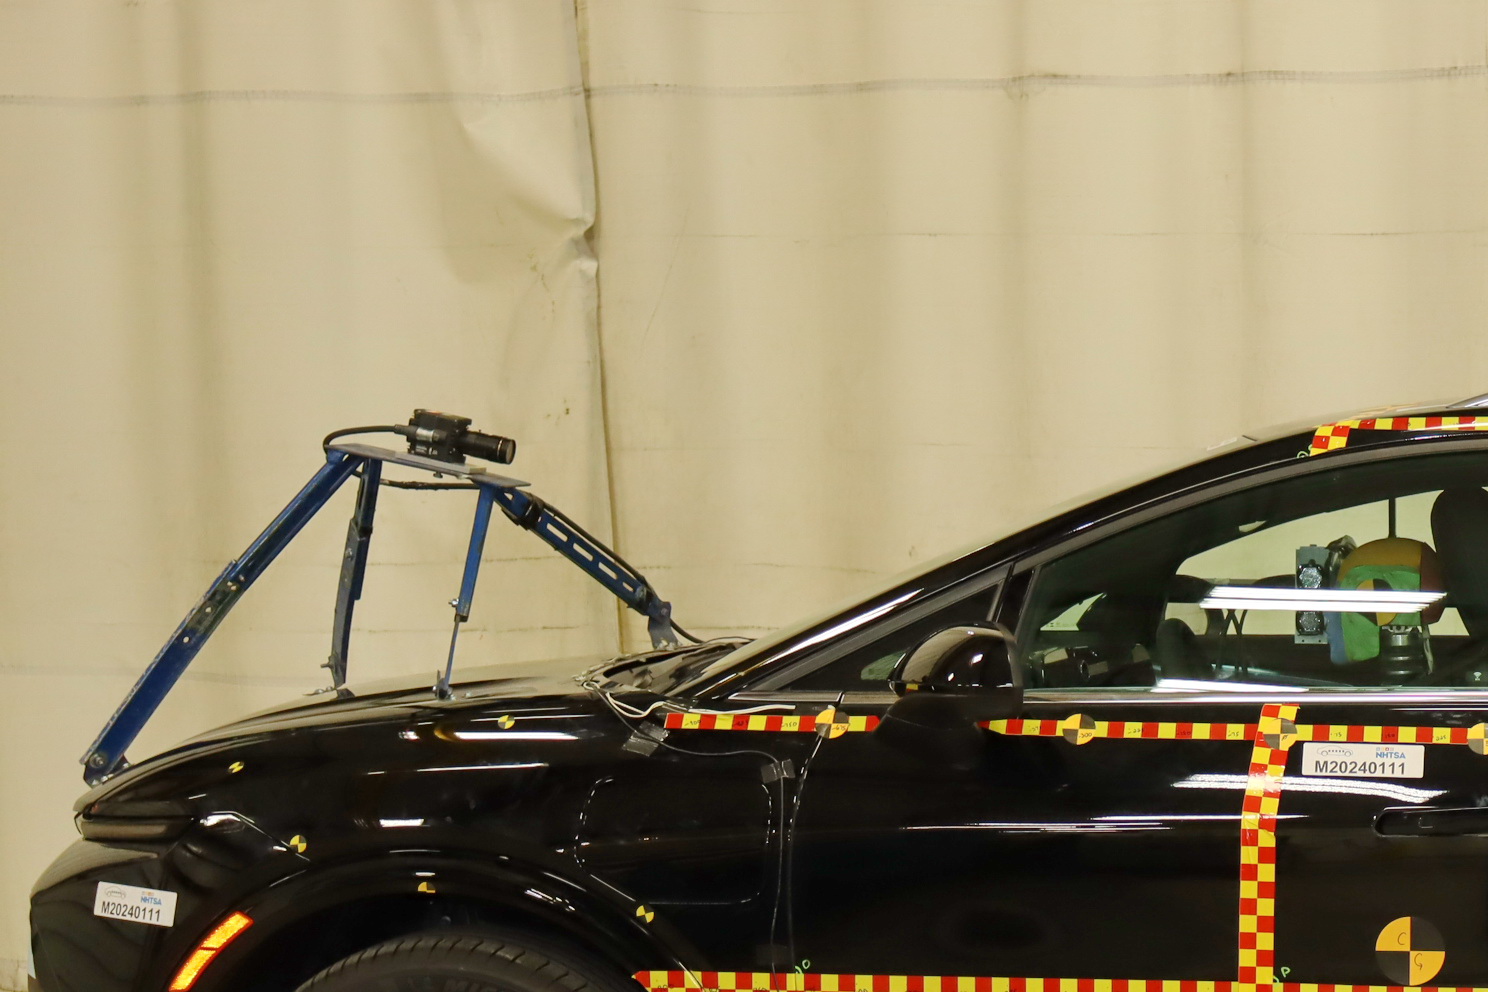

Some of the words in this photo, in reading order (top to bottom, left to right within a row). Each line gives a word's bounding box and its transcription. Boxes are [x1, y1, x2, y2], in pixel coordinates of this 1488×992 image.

[1375, 751, 1406, 759] NHTSA
[1314, 760, 1406, 775] M20240111
[140, 896, 162, 906] NHTSA
[101, 901, 161, 922] M20240111
